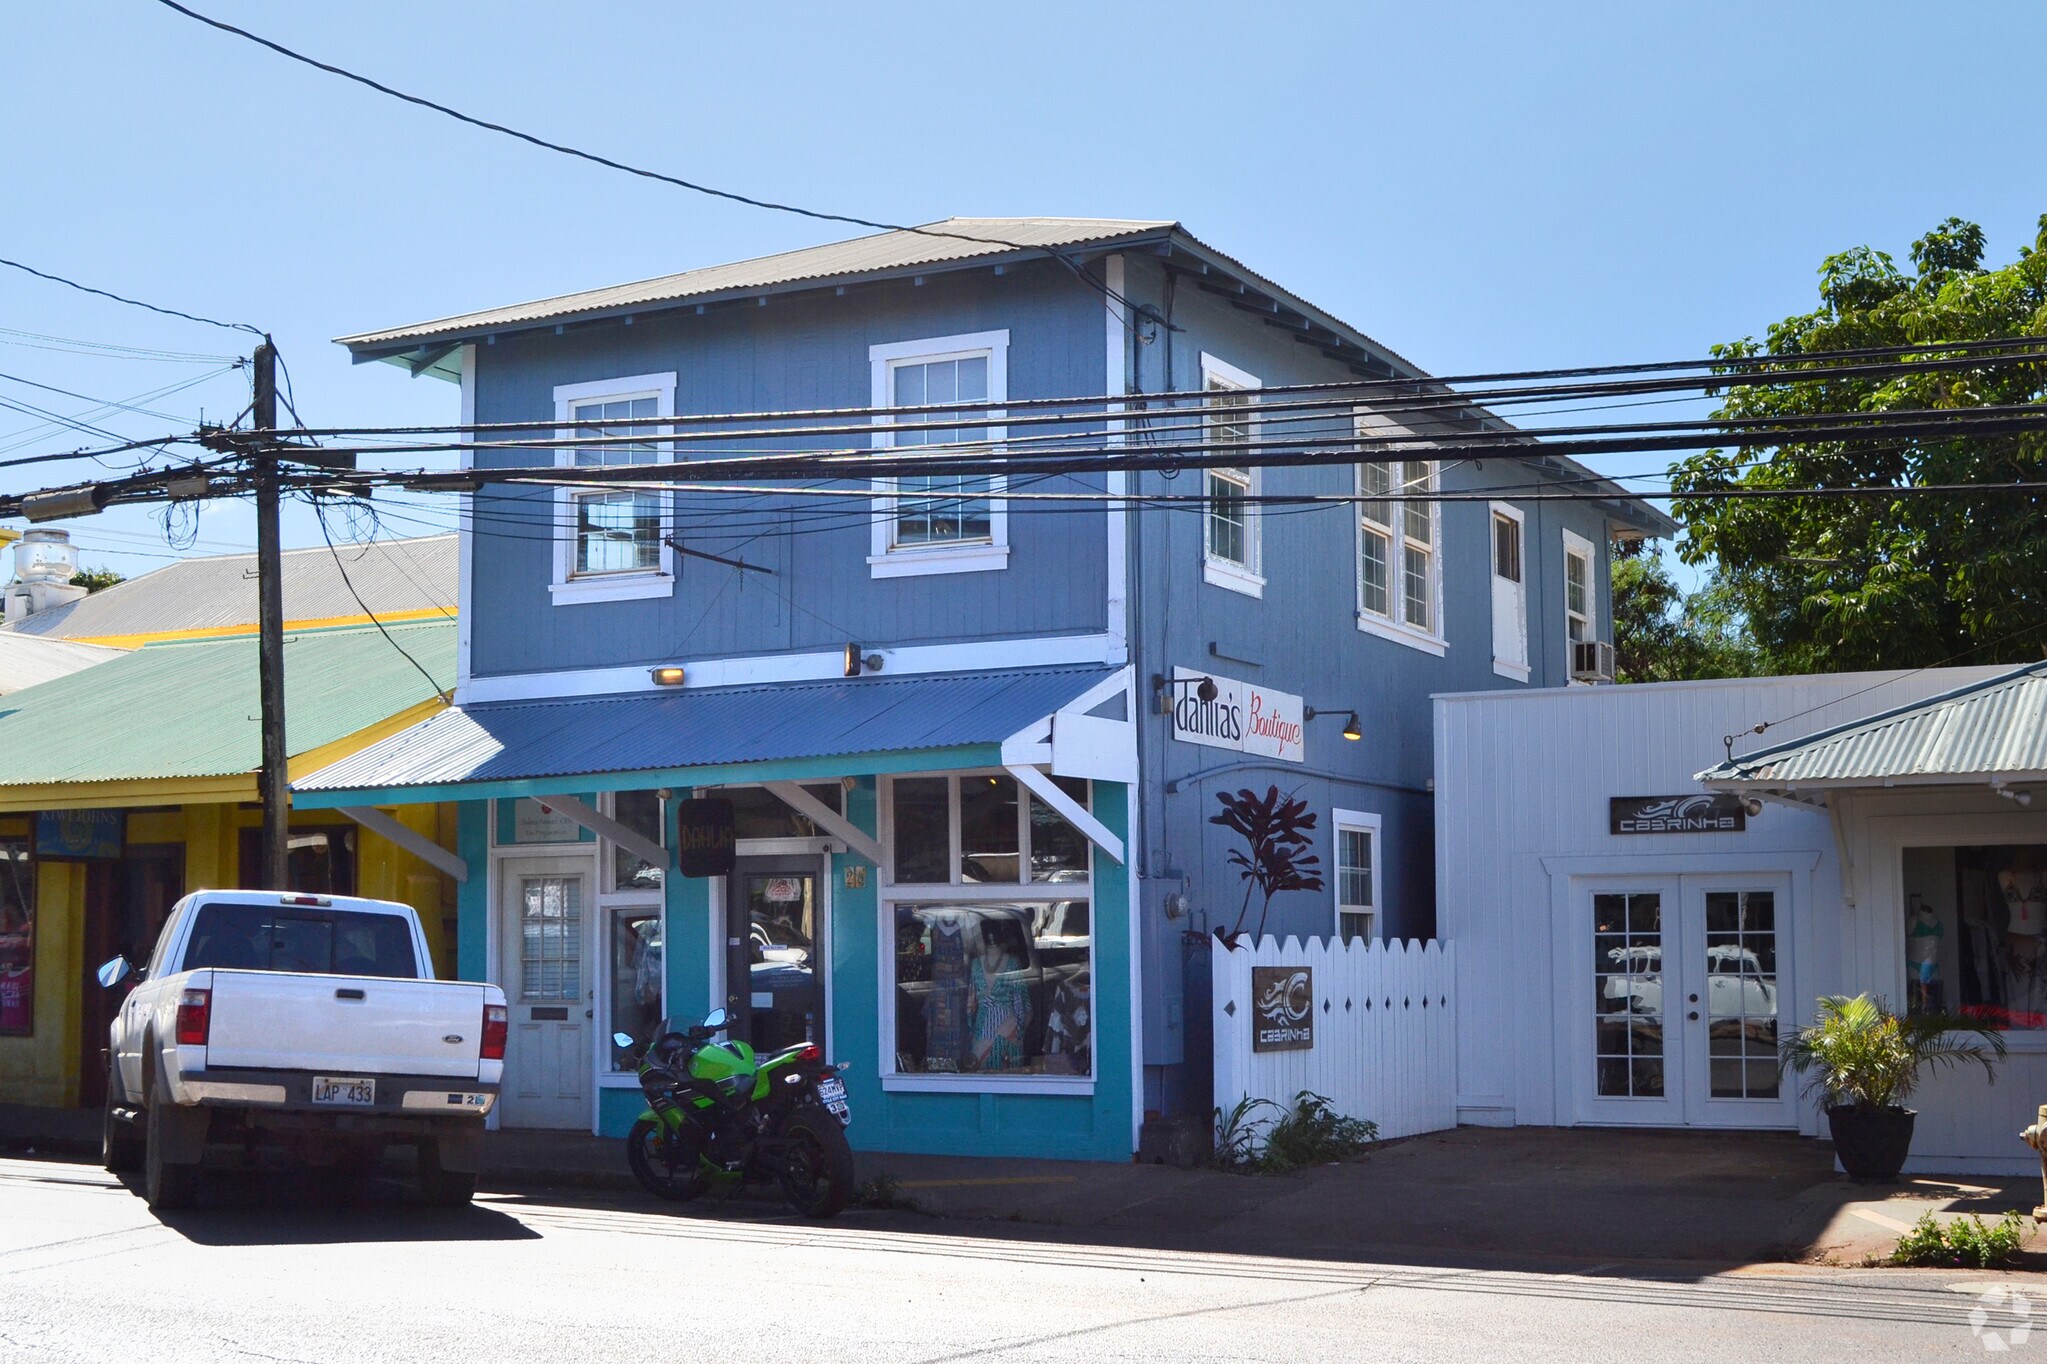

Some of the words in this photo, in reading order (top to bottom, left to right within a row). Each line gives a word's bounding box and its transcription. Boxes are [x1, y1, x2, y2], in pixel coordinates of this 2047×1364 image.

[1245, 690, 1302, 756] Boutique
[316, 1084, 340, 1101] LAP
[347, 1085, 372, 1102] 433
